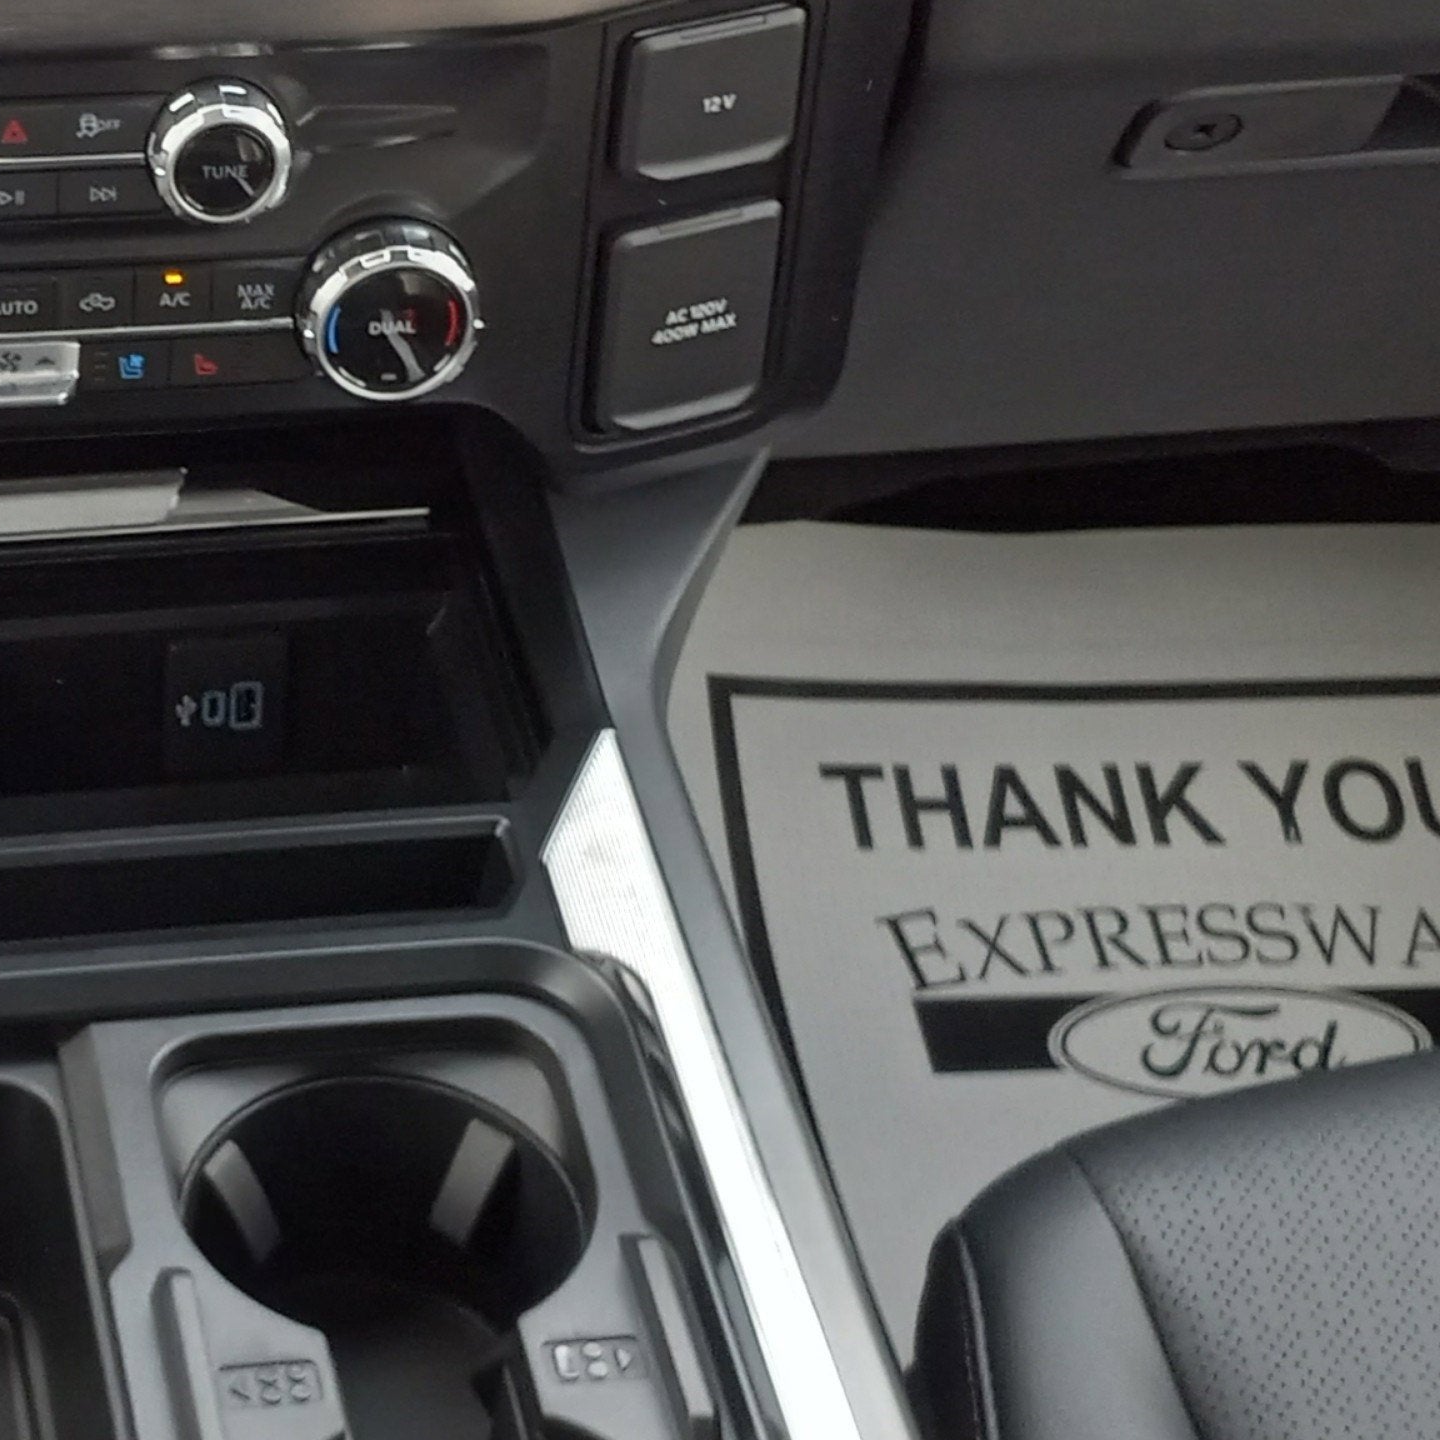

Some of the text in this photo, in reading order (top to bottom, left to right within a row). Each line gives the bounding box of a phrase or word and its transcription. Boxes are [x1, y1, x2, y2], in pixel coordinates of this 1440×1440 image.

[201, 164, 249, 180] TUNE
[236, 282, 276, 298] MAX
[158, 292, 192, 308] A/C
[367, 319, 418, 336] DUAL
[818, 760, 1228, 854] THANK
[1138, 998, 1350, 1078] Ford
